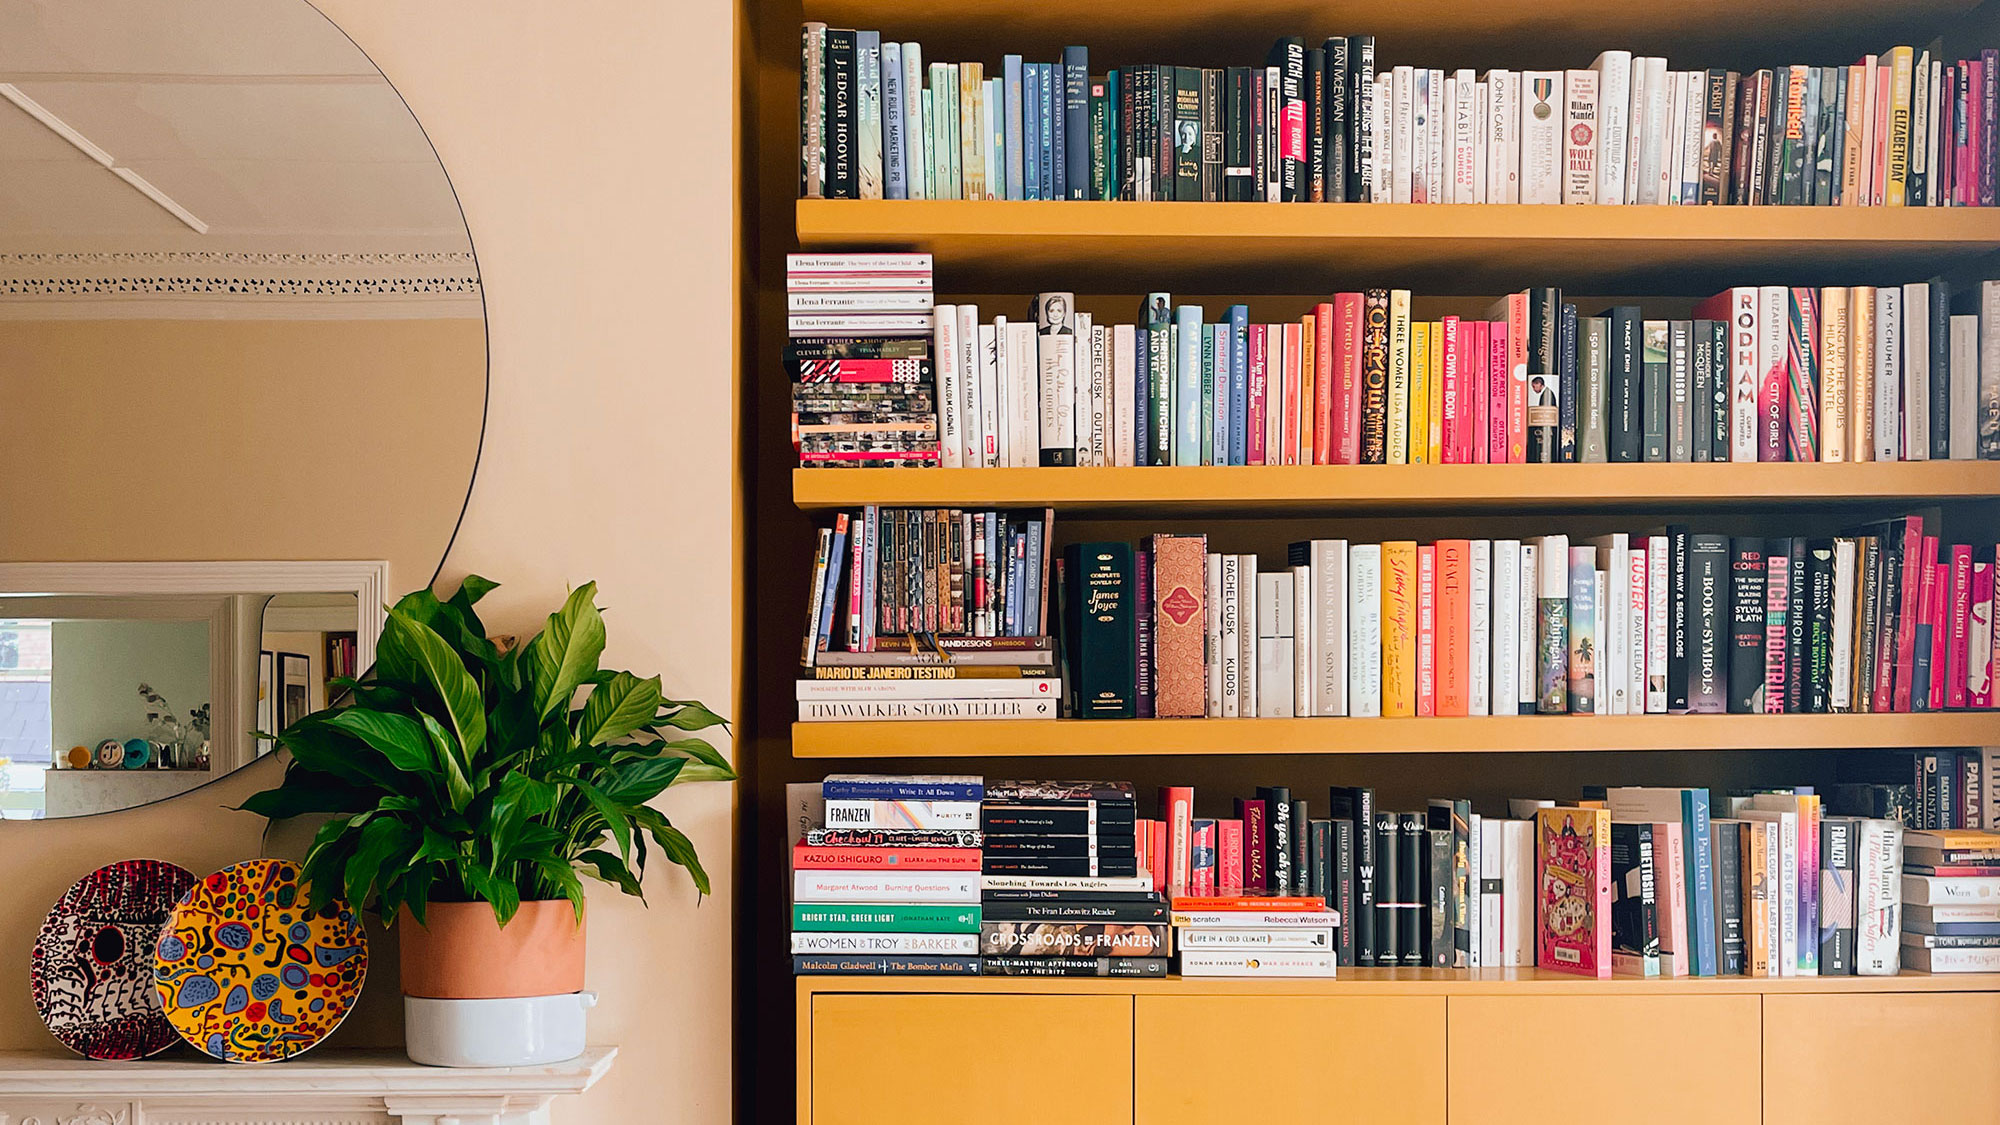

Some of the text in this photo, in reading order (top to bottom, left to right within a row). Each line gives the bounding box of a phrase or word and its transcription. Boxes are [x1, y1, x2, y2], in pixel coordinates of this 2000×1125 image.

[835, 59, 847, 180] J. EDGAR HOOVER
[1284, 44, 1303, 189] CATCH AND KILL RONAN FARROW
[1457, 101, 1468, 143] HABIT
[1786, 67, 1806, 139] Atomised
[888, 78, 899, 182] NEW RULES MARKETING PR
[1891, 109, 1907, 183] ELIZABETH DAY
[1313, 137, 1323, 192] PIRANESI
[1569, 149, 1593, 159] WOLF
[1570, 161, 1592, 171] HALL
[1771, 293, 1779, 341] ELIZABETH
[1885, 294, 1893, 376] AMY SCHUMER
[1695, 344, 1704, 389] McQUEEN
[1737, 295, 1754, 404] RODHAM
[1825, 324, 1834, 412] HILARY MANTEL
[1837, 308, 1845, 429] BRING UP THE BODIES
[945, 377, 953, 406] MALCOLM
[1094, 329, 1102, 456] RACHEL CUSK OUTLINE
[1159, 329, 1168, 451] CHRISTOPHER HITCHENS
[1218, 330, 1226, 420] Standard Deviation
[1393, 314, 1405, 458] THREE WOMEN LISA TADDEO
[1770, 382, 1778, 403] CITY
[1366, 414, 1375, 451] MILLER
[1770, 404, 1778, 419] OF
[1769, 421, 1778, 448] GIRLS
[1676, 534, 1684, 574] WALTERS
[1088, 589, 1119, 604] James
[1676, 574, 1684, 591] WAY
[1814, 572, 1822, 611] GORDON
[1955, 554, 1970, 638] Gloria Steinem
[1089, 599, 1118, 614] Joyce
[1632, 556, 1644, 683] LUSTER RAVEN LEILANI
[1655, 547, 1667, 663] FIRE AND FURY
[1676, 601, 1684, 630] SEGAL
[1735, 606, 1763, 614] SYLVIA
[1735, 614, 1763, 622] PLATH
[1226, 560, 1235, 696] RACHEL CUSK KUDOS
[1549, 603, 1563, 670] Nightingale
[1702, 561, 1714, 694] THE BOOK OF SYMBOLS
[1765, 556, 1788, 714] BITCH DOCTRINE
[816, 667, 852, 680] MARIO
[853, 667, 867, 680] DE
[867, 667, 911, 680] JANEIRO
[913, 666, 956, 679] TESTINO
[1811, 622, 1820, 683] ROCK BOTTOM
[808, 702, 1021, 717] TIM WALKER STORY TELLER
[830, 808, 871, 822] FRANZEN
[1362, 792, 1370, 827] ROBERT
[1230, 828, 1239, 866] FURIOUS
[1697, 801, 1709, 891] Ann Patchett
[1880, 829, 1894, 901] Hilary Mantel
[816, 884, 848, 892] Margaret
[885, 884, 913, 892] Burning
[914, 884, 950, 892] Questions
[987, 880, 1027, 888] Slouching
[1784, 853, 1793, 944] ACTS OF SERVICE
[1026, 907, 1116, 916] The Fran Lebowitz Reader
[807, 938, 957, 949] WOMEN TROY BARKER
[990, 933, 1160, 947] CROSSROADS FRANZEN
[802, 961, 963, 971] Malcolm Gladwell The Bomber Mafia
